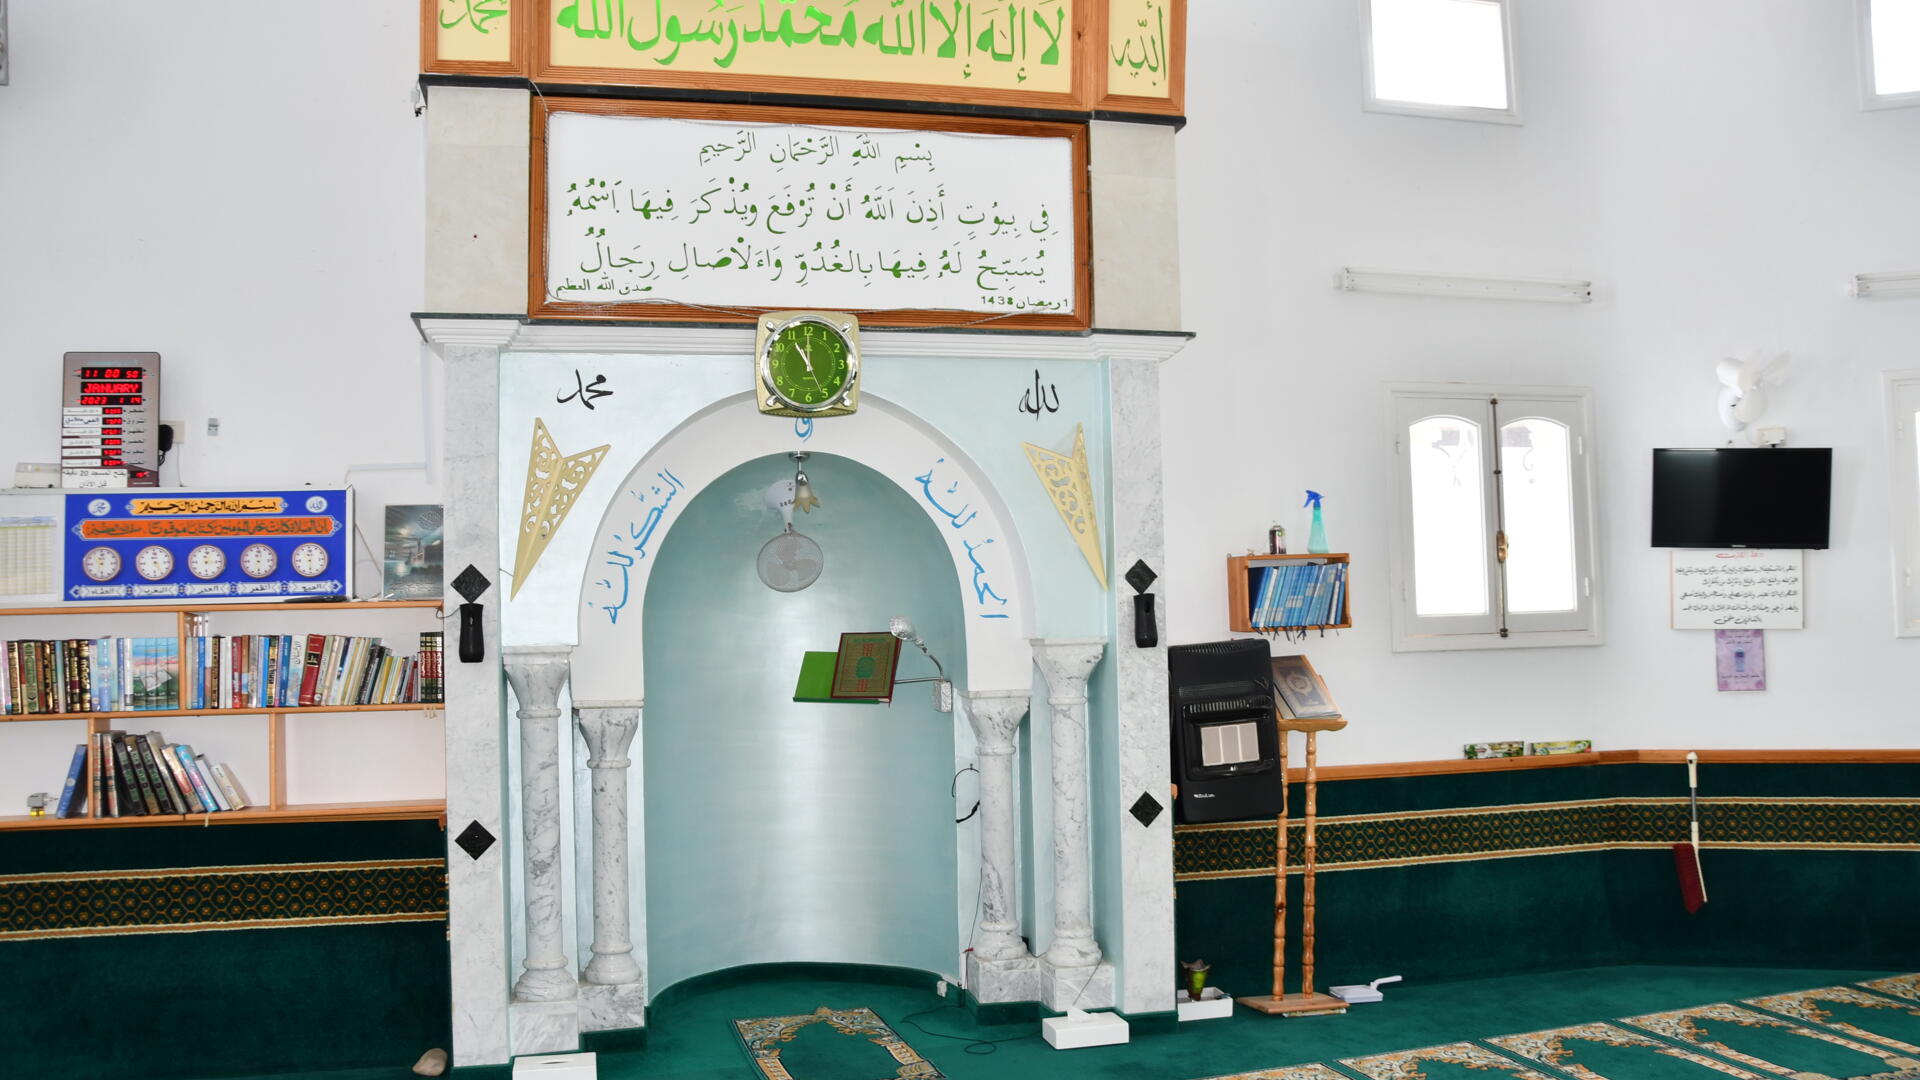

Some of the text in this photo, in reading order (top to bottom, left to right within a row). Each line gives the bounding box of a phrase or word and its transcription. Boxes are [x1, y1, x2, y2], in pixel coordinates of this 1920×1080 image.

[980, 295, 1014, 305] 1438
[787, 331, 796, 340] 11
[803, 326, 814, 336] 12
[822, 331, 827, 340] 1
[775, 343, 784, 352] 10
[834, 343, 840, 352] 2
[772, 360, 779, 369] 9
[838, 360, 845, 369] 3
[86, 369, 98, 378] 11
[104, 369, 120, 378] 00
[776, 376, 783, 386] 8
[833, 376, 840, 386] 4
[84, 383, 139, 393] JANUARY
[557, 369, 614, 410] محمد
[788, 388, 796, 398] 7
[805, 393, 812, 402] 6
[822, 388, 829, 398] 5
[81, 396, 108, 405] 2023
